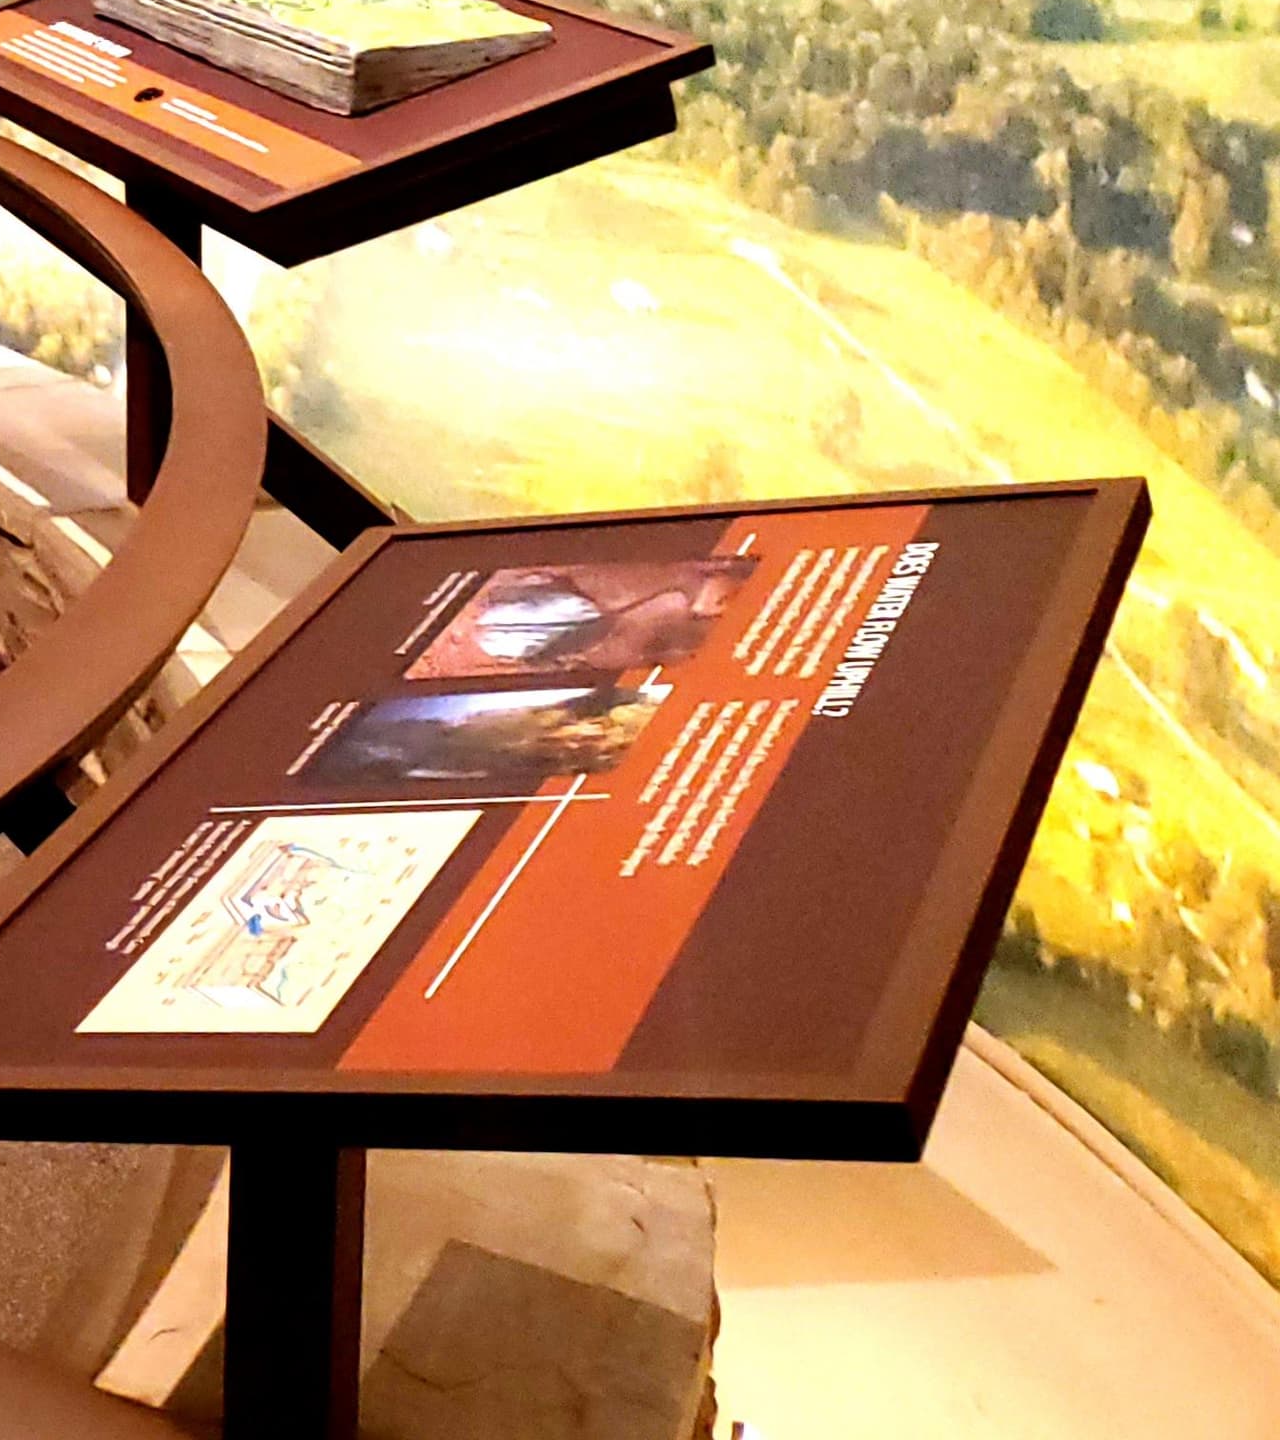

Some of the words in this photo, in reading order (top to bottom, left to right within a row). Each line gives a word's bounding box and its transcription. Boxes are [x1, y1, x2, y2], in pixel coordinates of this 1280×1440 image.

[892, 542, 941, 576] DOES
[864, 575, 923, 621] WATER
[843, 619, 898, 660] FLOW
[811, 660, 876, 718] UPHILL?
